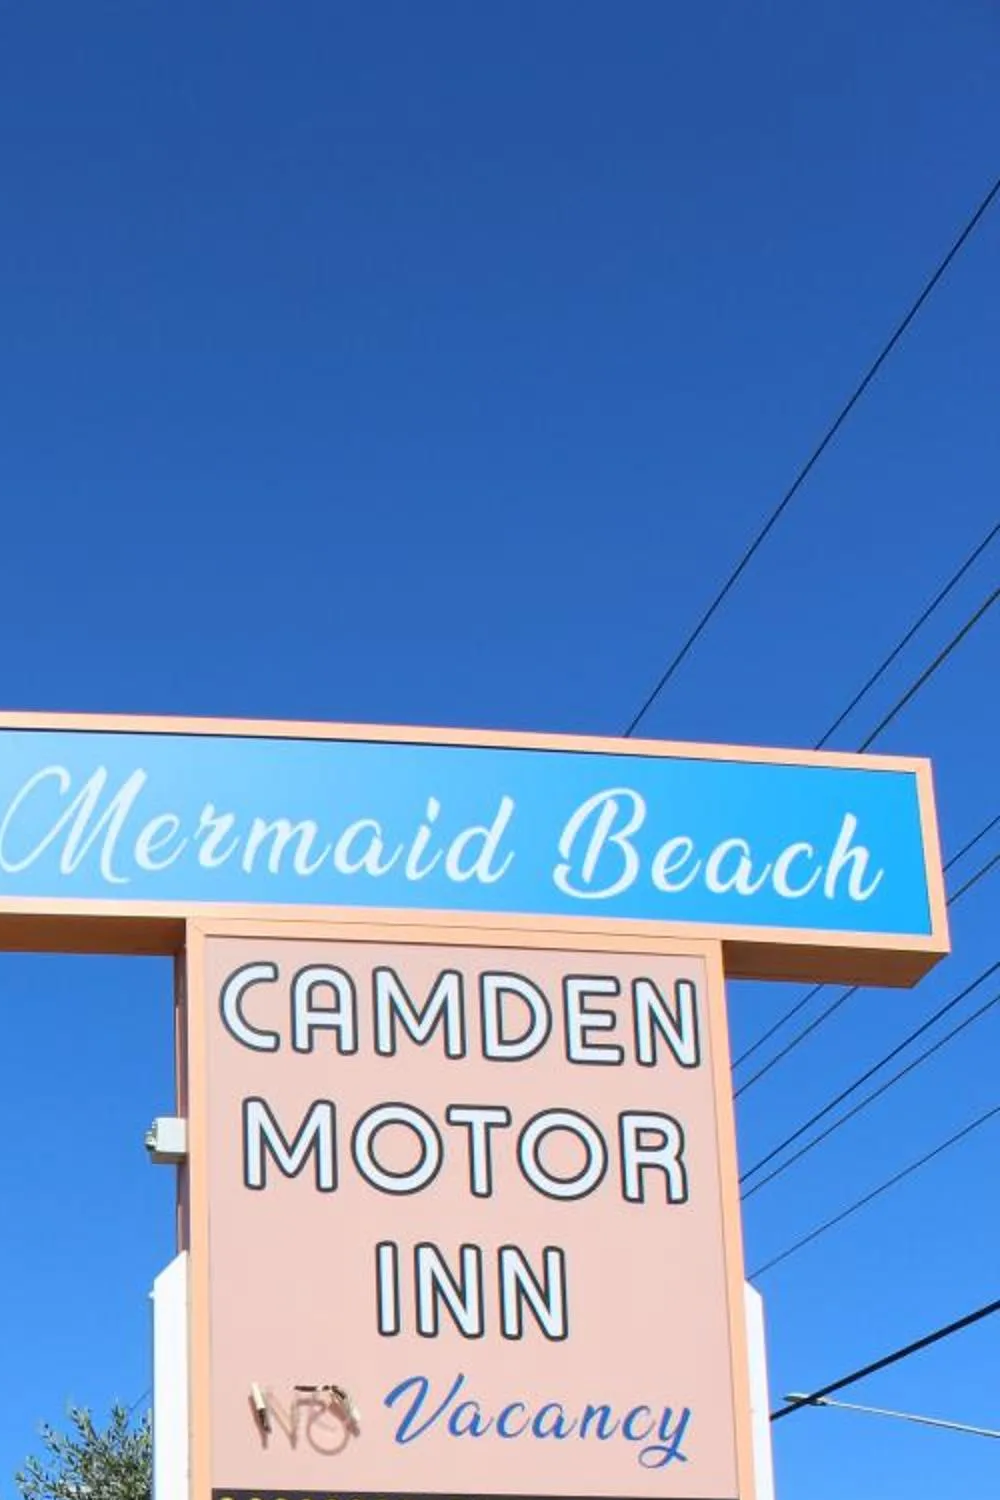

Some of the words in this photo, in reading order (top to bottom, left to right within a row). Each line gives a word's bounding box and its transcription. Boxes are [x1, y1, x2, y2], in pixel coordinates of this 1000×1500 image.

[553, 788, 882, 902] Beach
[220, 961, 701, 1068] CAMDEN
[242, 1097, 688, 1204] MOTOR
[376, 1241, 569, 1341] INN
[384, 1373, 691, 1468] Vacancy
